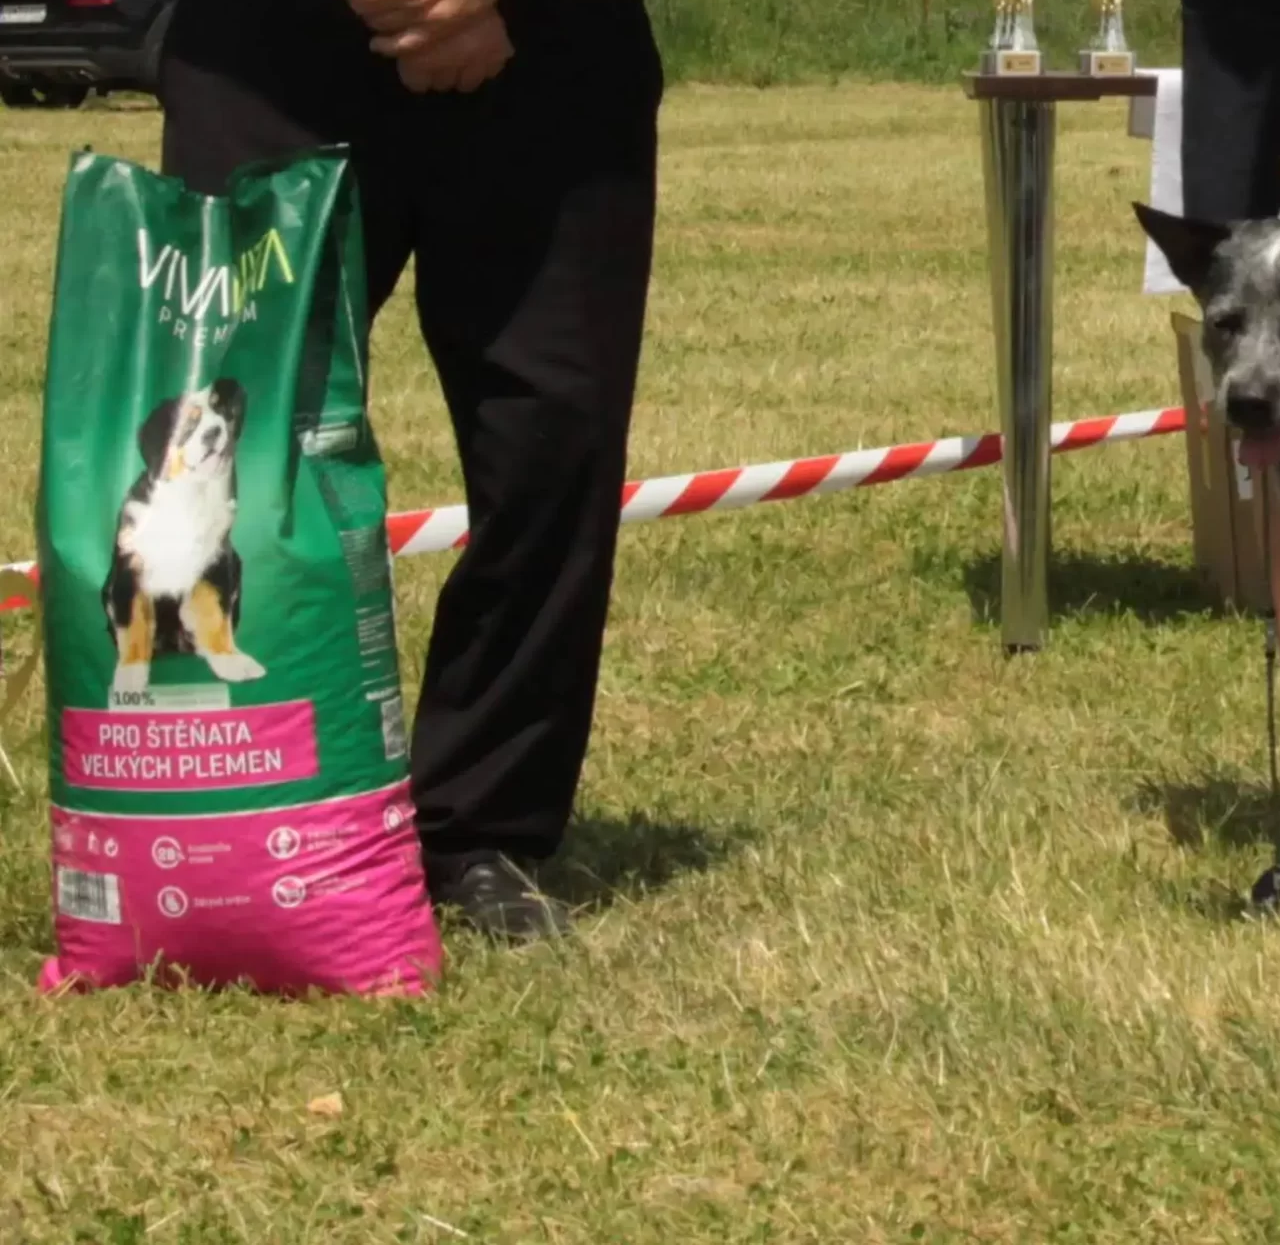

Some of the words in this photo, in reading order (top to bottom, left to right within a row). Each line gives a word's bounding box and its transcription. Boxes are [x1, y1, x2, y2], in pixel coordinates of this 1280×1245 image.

[158, 301, 257, 347] PREMM
[113, 692, 155, 706] 100%
[99, 723, 140, 749] PRO
[146, 718, 252, 747] ŠTĚŇATA
[81, 750, 171, 778] VELKÝCH
[178, 749, 282, 777] PLEMEN
